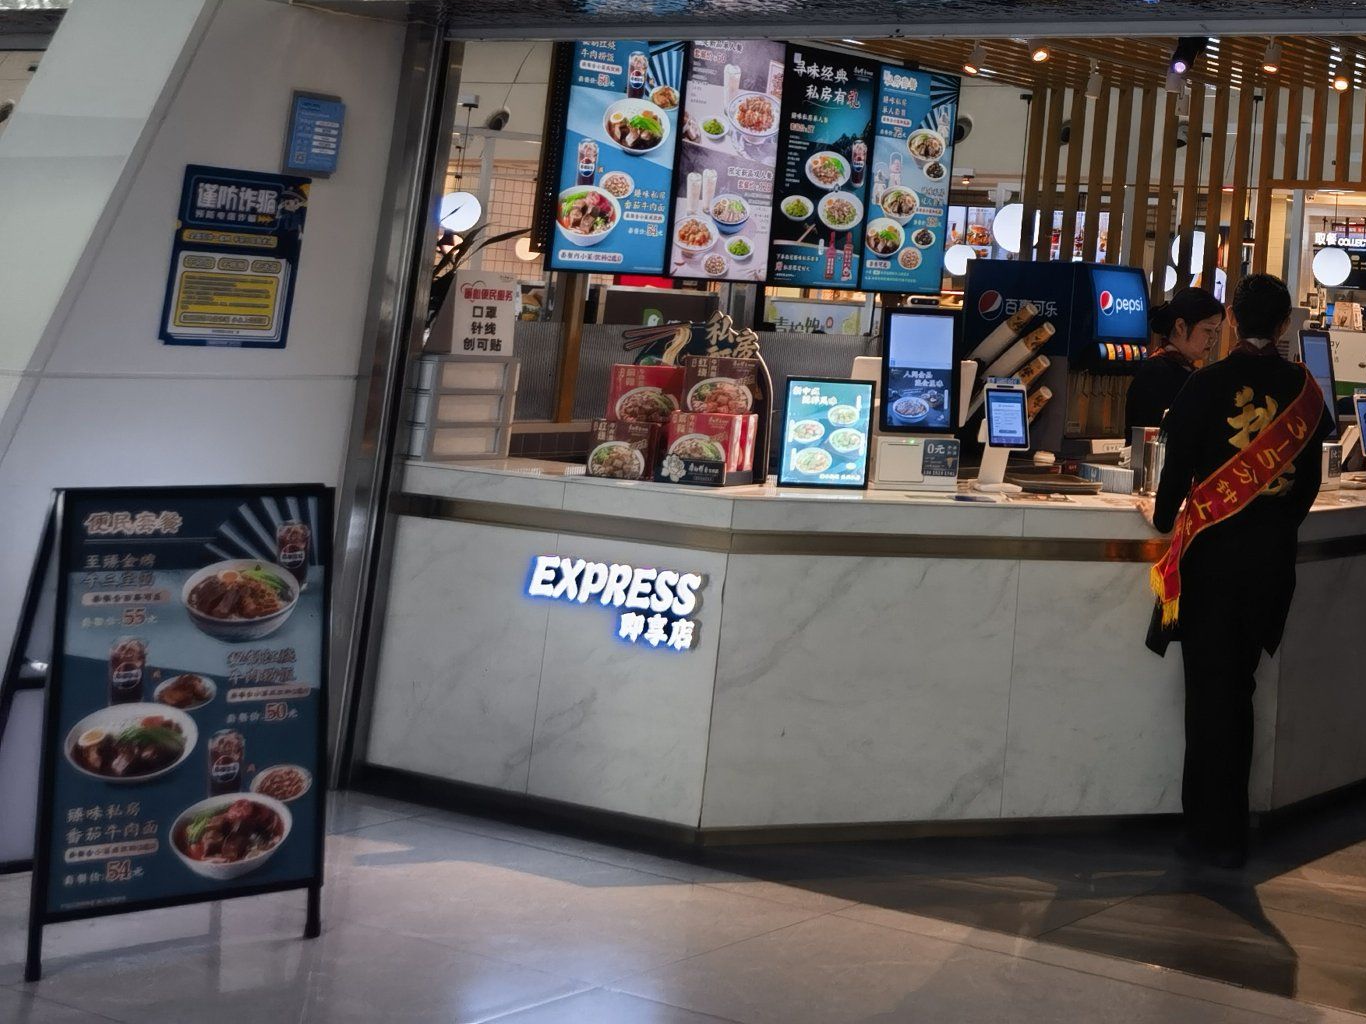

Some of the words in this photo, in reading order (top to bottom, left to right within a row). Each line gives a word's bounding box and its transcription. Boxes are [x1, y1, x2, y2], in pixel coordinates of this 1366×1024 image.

[793, 61, 848, 84] 寻味经典
[197, 183, 278, 213] 谨防诈骗
[472, 306, 497, 318] 口罩
[1116, 297, 1144, 314] pepsi
[471, 322, 496, 335] 针线
[463, 337, 502, 352] 创可贴
[927, 443, 945, 454] 0元
[84, 511, 183, 535] 便民套餐
[529, 556, 702, 615] EXPRESS
[619, 612, 695, 651] 即享店
[65, 820, 158, 844] 番茄牛肉面
